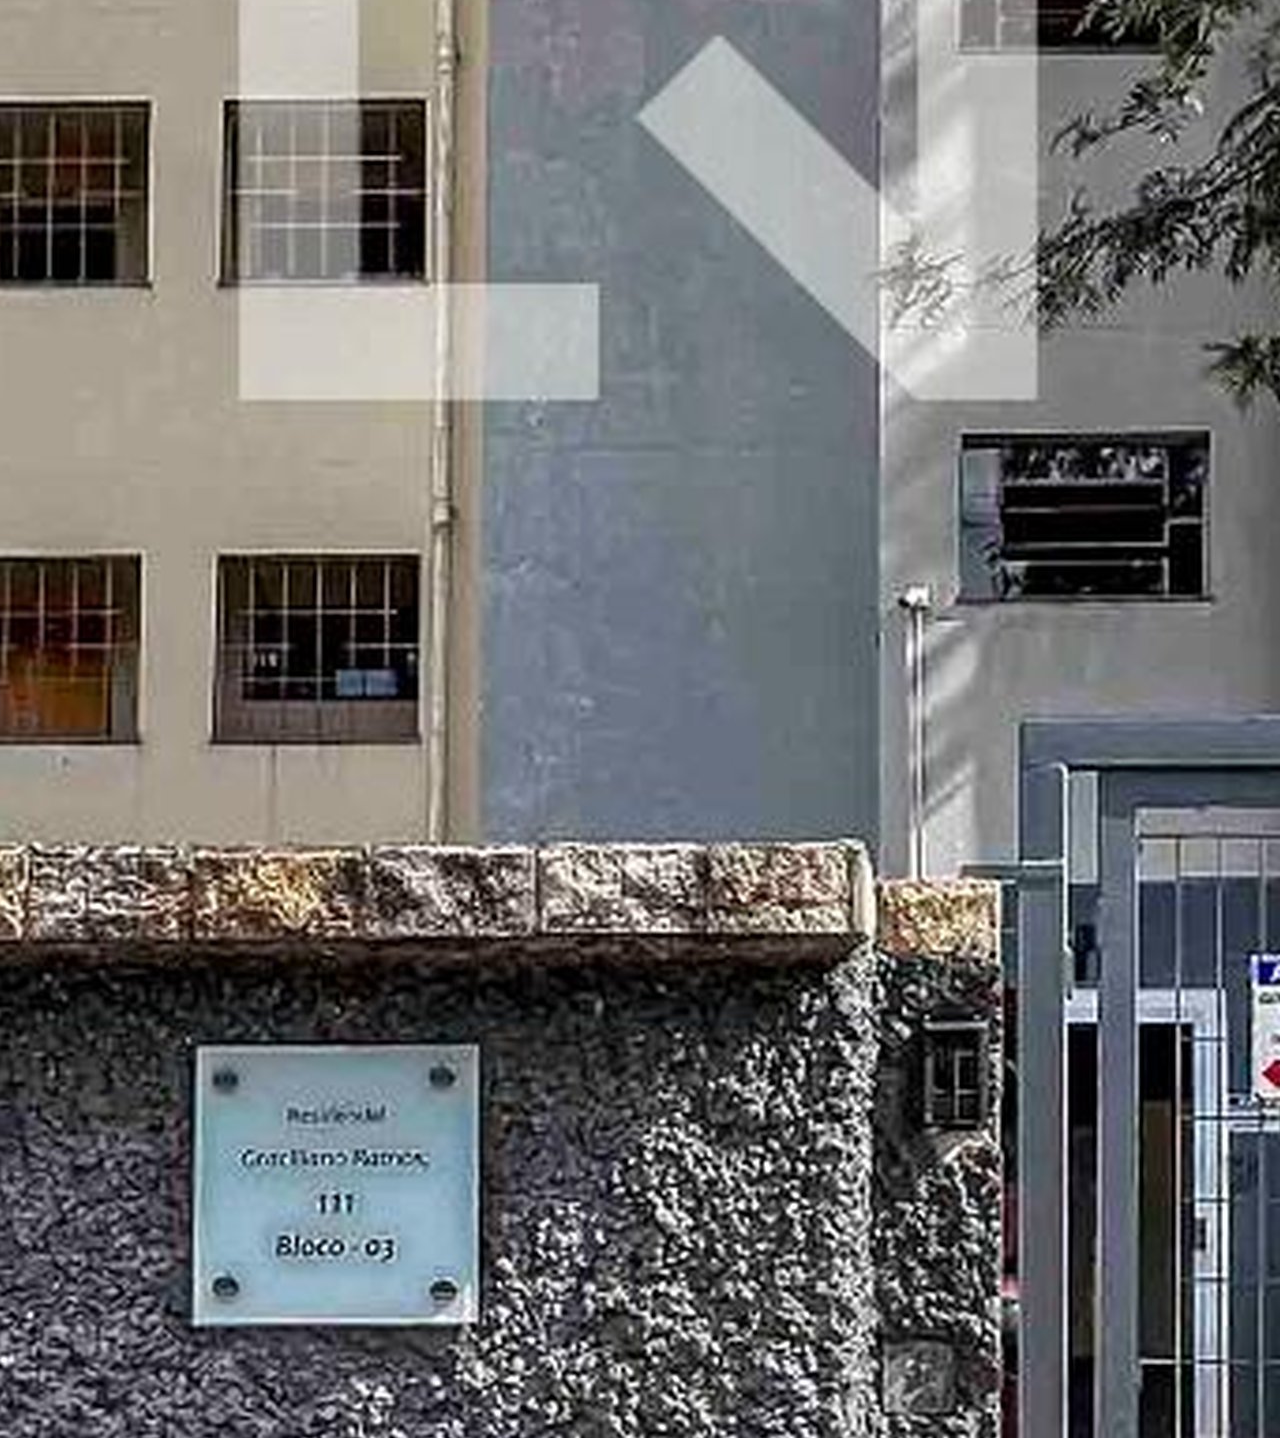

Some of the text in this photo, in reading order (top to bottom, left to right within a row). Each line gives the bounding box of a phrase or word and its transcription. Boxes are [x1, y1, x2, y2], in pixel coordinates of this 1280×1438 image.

[319, 1193, 355, 1214] 111
[275, 1234, 345, 1257] Bloco
[364, 1238, 395, 1261] 03
